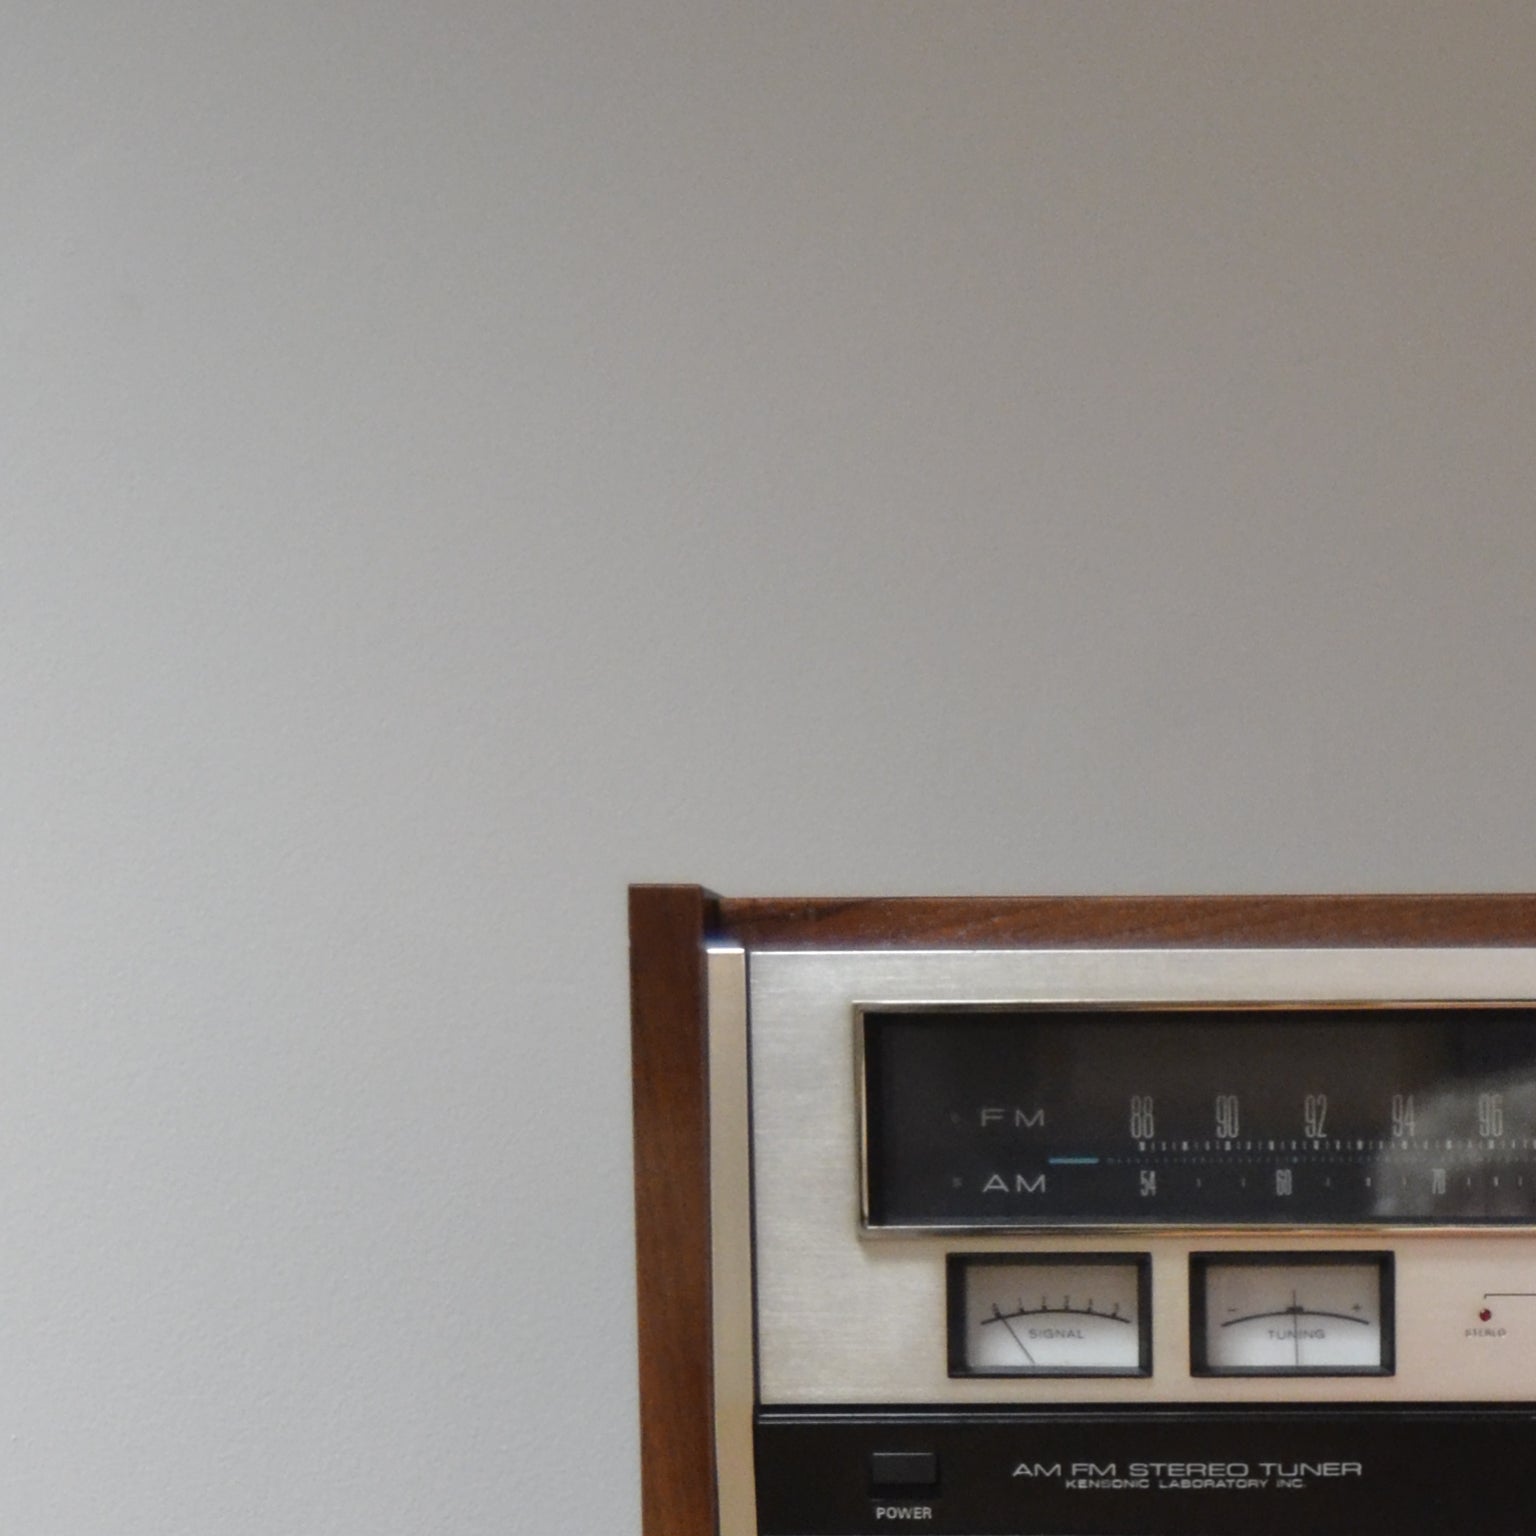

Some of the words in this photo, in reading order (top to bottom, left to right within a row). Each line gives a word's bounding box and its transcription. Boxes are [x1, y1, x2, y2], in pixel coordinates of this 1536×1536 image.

[981, 1109, 1044, 1127] FM
[1131, 1096, 1154, 1138] 88
[1216, 1096, 1239, 1138] 90
[1305, 1095, 1327, 1138] 92
[1392, 1094, 1415, 1137] 94
[1479, 1094, 1502, 1137] 96
[982, 1175, 1046, 1192] AM
[1140, 1171, 1156, 1196] 54
[1029, 1329, 1084, 1339] SIGNAL
[1268, 1330, 1325, 1340] TUNING
[1013, 1463, 1060, 1477] AM
[1072, 1463, 1116, 1477] FM
[1130, 1463, 1248, 1477] STEREO
[1259, 1462, 1362, 1477] TUNER
[1065, 1479, 1150, 1489] KENSONIC
[1159, 1479, 1266, 1489] LABORATORY
[876, 1507, 932, 1520] POWER
